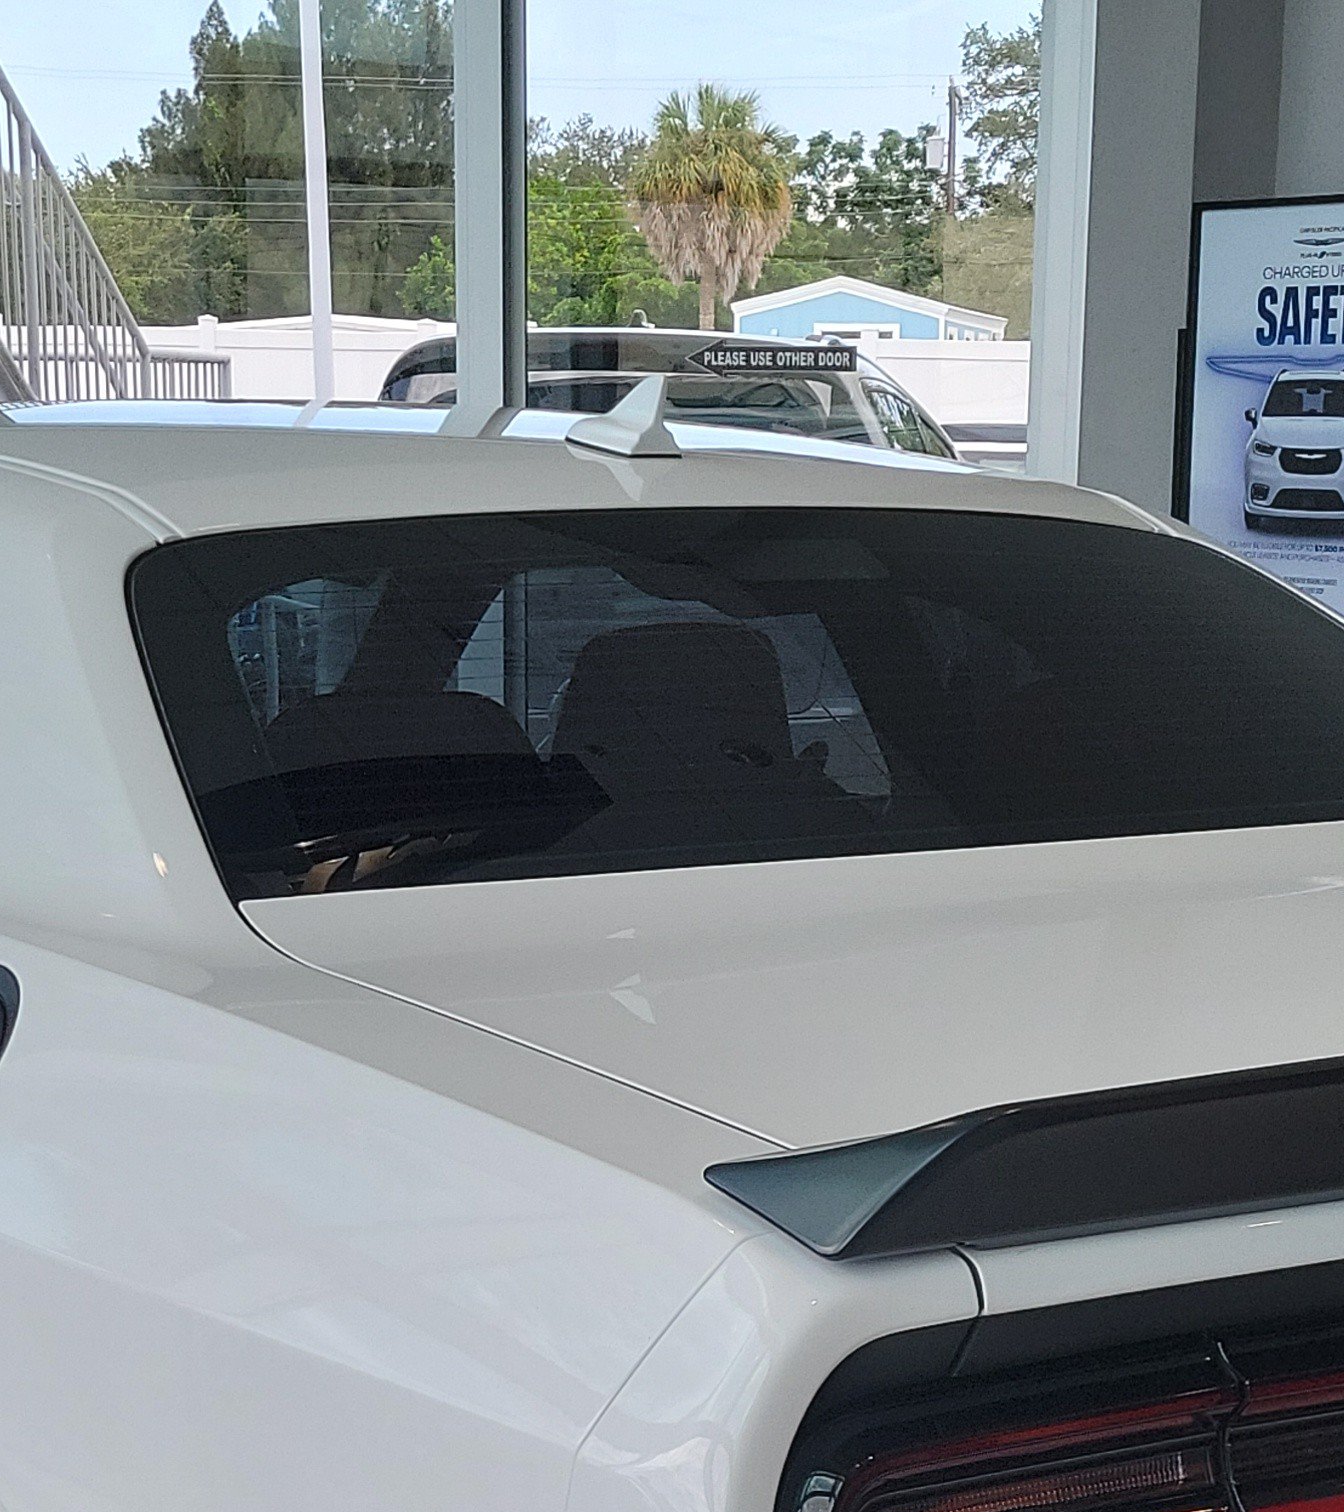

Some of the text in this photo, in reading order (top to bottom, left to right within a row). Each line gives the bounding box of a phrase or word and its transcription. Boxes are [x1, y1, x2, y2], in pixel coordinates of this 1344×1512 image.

[1262, 265, 1329, 280] CHARGED
[704, 351, 850, 367] PLEASE USE OTHER DOOR
